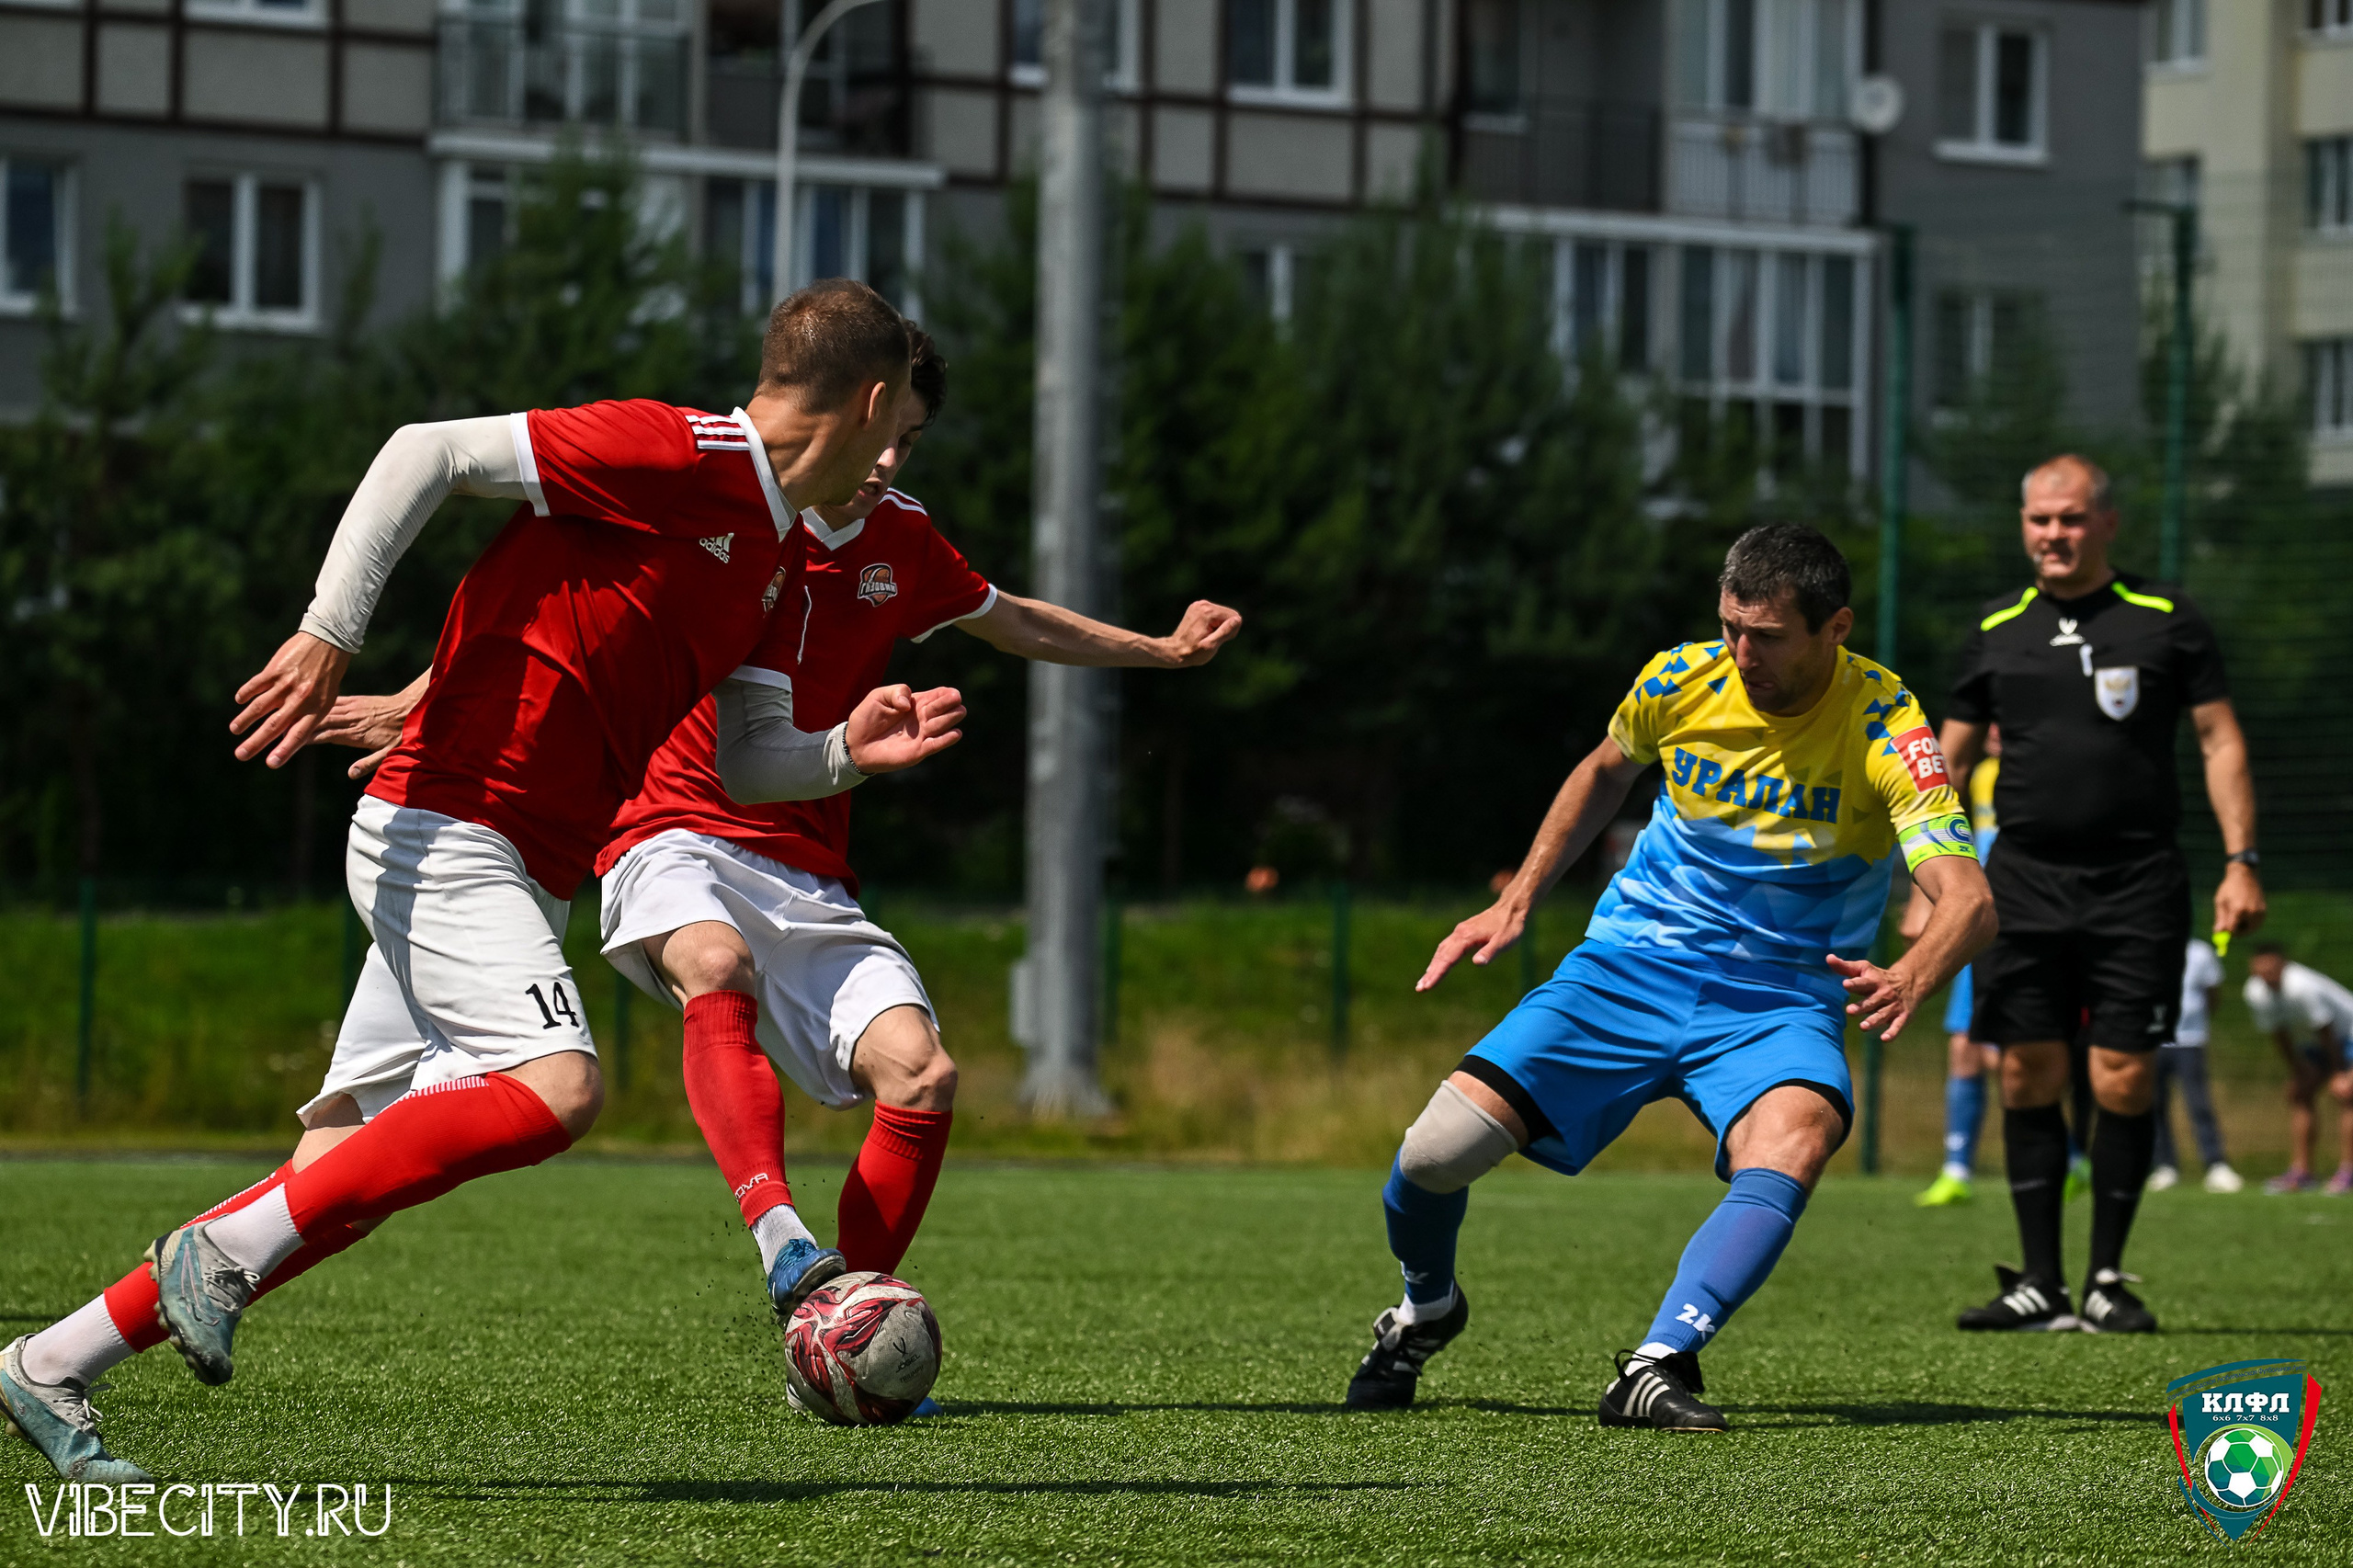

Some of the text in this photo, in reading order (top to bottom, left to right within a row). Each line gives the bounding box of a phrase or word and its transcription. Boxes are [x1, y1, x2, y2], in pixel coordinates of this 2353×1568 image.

[699, 538, 730, 563] adidas
[1671, 746, 1841, 824] УРАЛАН
[525, 981, 580, 1029] 14
